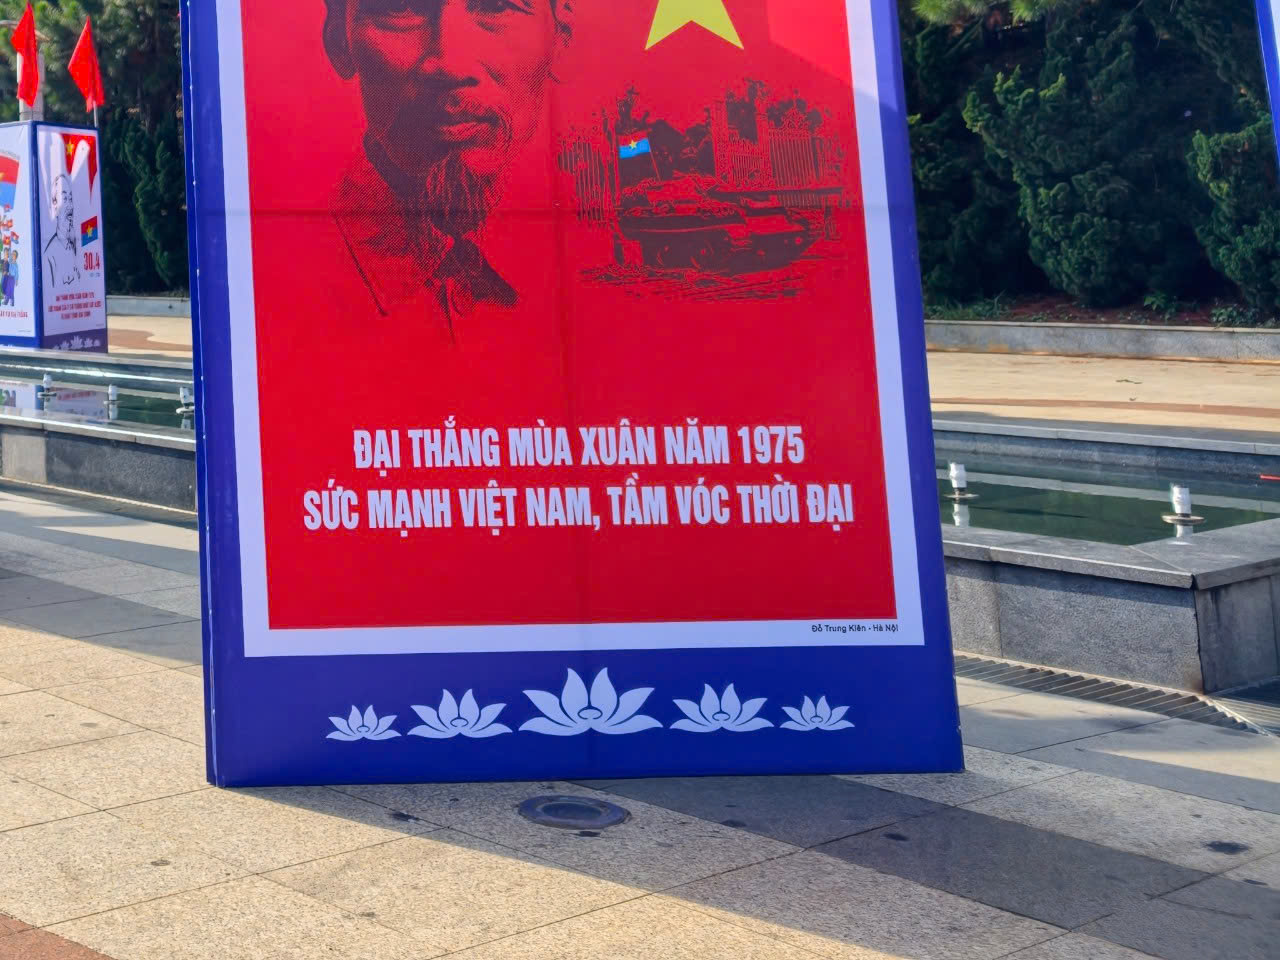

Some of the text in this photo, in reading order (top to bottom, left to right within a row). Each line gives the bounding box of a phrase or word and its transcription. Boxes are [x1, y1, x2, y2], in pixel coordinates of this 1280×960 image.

[353, 415, 805, 477] ĐẠI THẮNG MÙA XUÂN NĂM 1975
[303, 472, 854, 537] SỨC MẠNH VIỆT NAM, TẦM VÓC THỜI ĐẠI
[825, 624, 847, 633] Trung
[849, 624, 867, 632] Kiên
[873, 624, 884, 632] Hà
[885, 624, 899, 634] Nội
